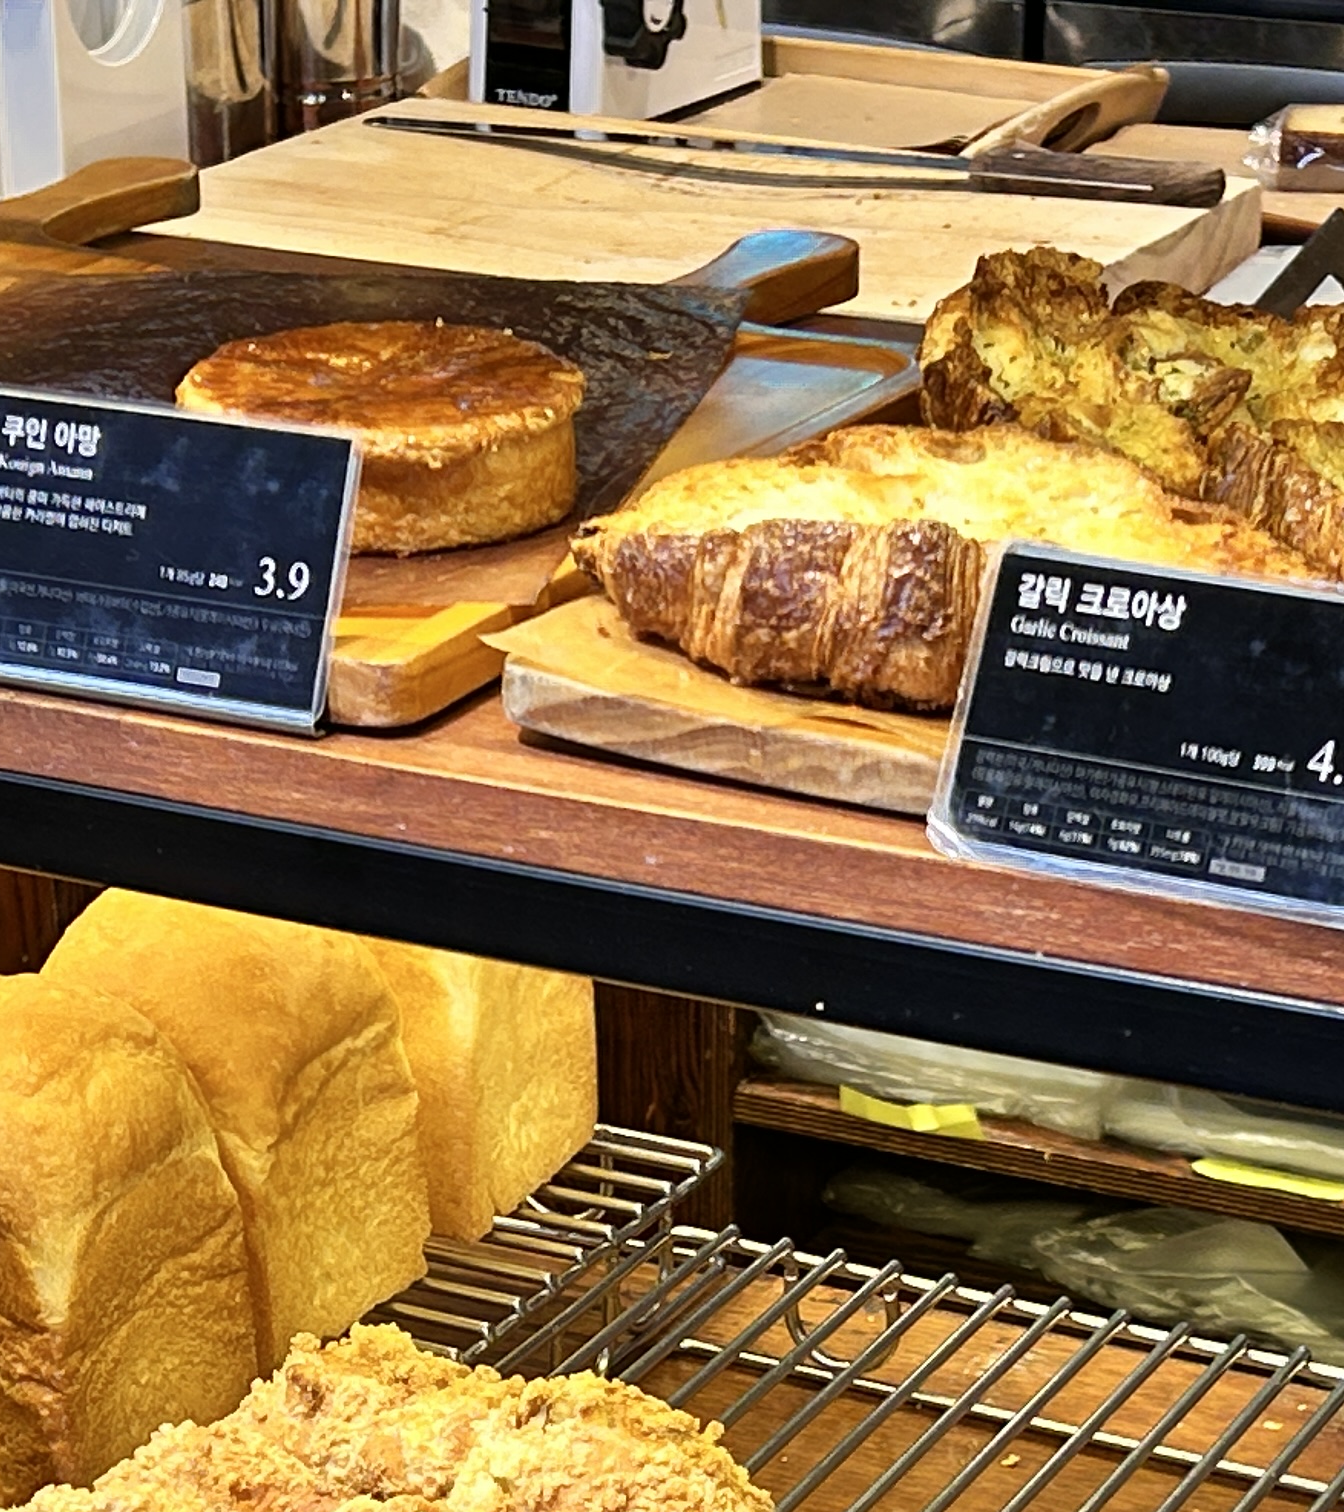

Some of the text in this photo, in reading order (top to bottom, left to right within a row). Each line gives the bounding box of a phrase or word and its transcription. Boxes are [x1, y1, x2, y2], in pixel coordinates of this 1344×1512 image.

[1, 415, 102, 457] 쿠인 아망
[254, 556, 310, 600] 3.9
[1018, 573, 1187, 631] 갈릭 크로아상
[1010, 615, 1130, 650] Garlic Croissant
